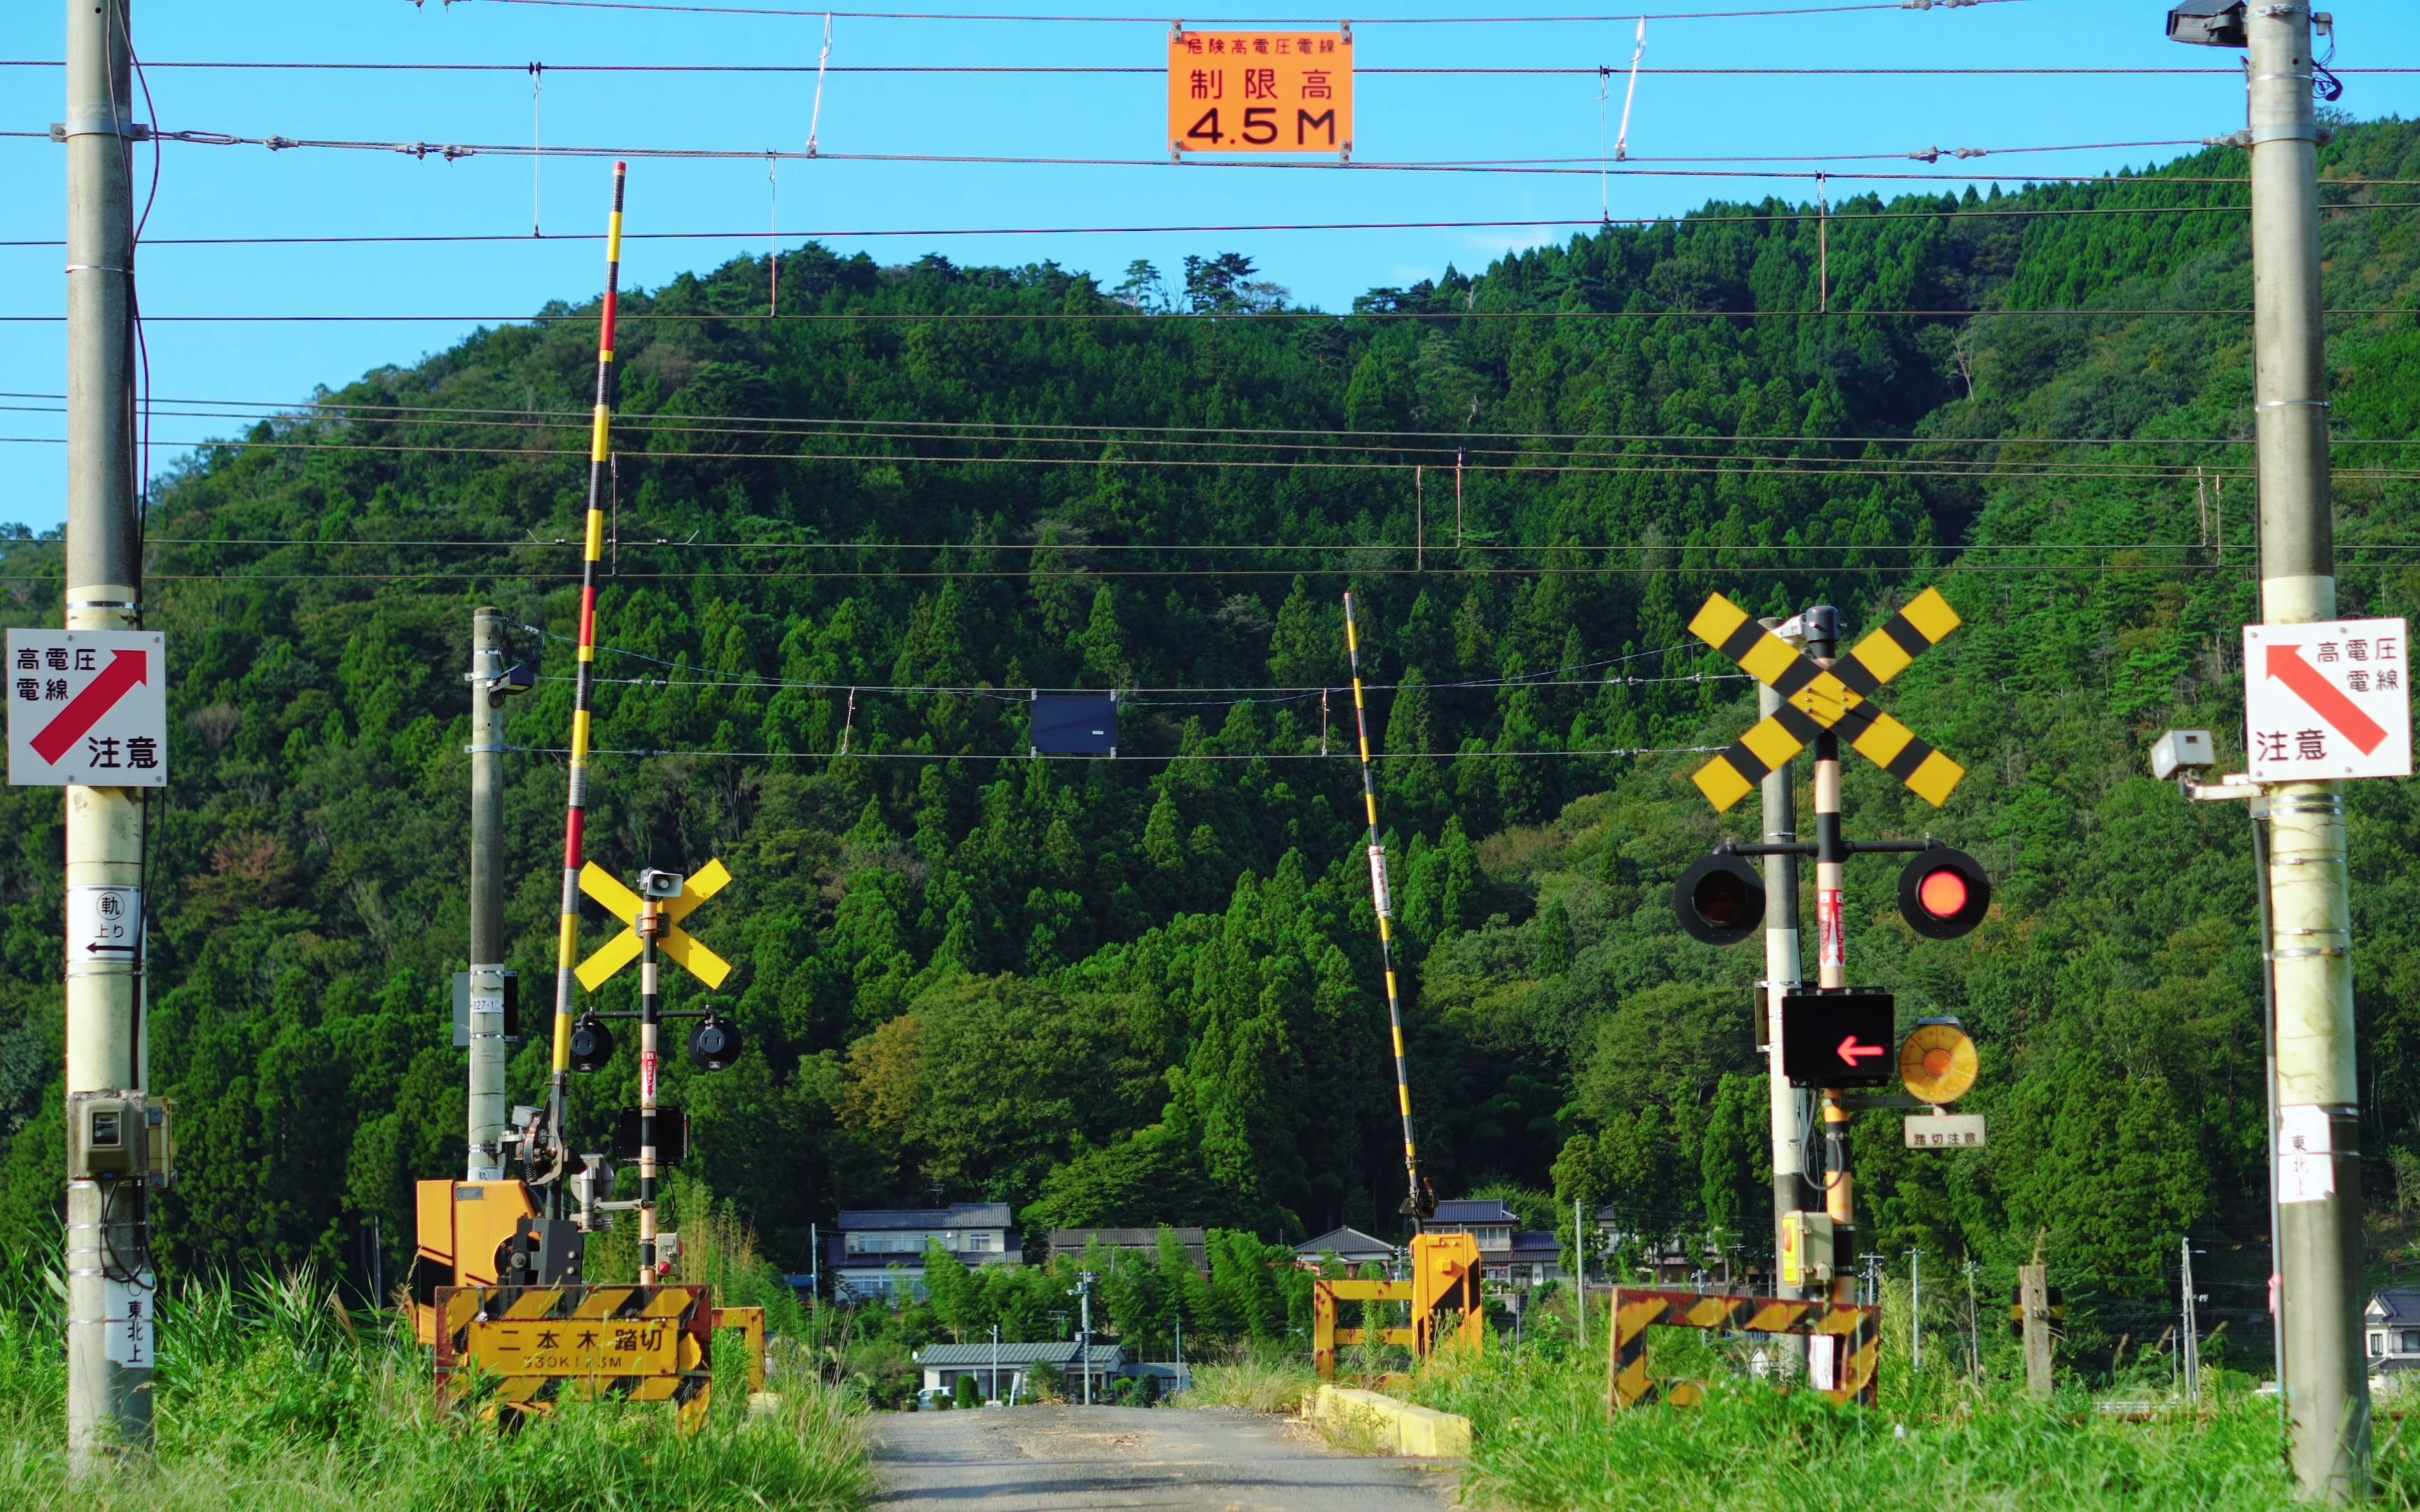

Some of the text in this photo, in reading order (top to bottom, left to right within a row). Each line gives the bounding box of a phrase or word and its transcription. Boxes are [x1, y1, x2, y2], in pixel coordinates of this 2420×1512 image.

[1187, 38, 1335, 55] 危険高電圧電線
[1190, 69, 1332, 99] 制限高
[18, 648, 97, 671] 高電圧
[2316, 638, 2397, 663] 高電圧
[17, 678, 69, 701] 電線
[2347, 669, 2399, 692] 電線
[88, 736, 158, 769] 注意
[2256, 729, 2327, 762] 注意
[99, 895, 123, 917] 軌
[95, 924, 124, 938] 上り
[1914, 1132, 1976, 1146] 踏切注意
[498, 1329, 662, 1352] 二本木踏切
